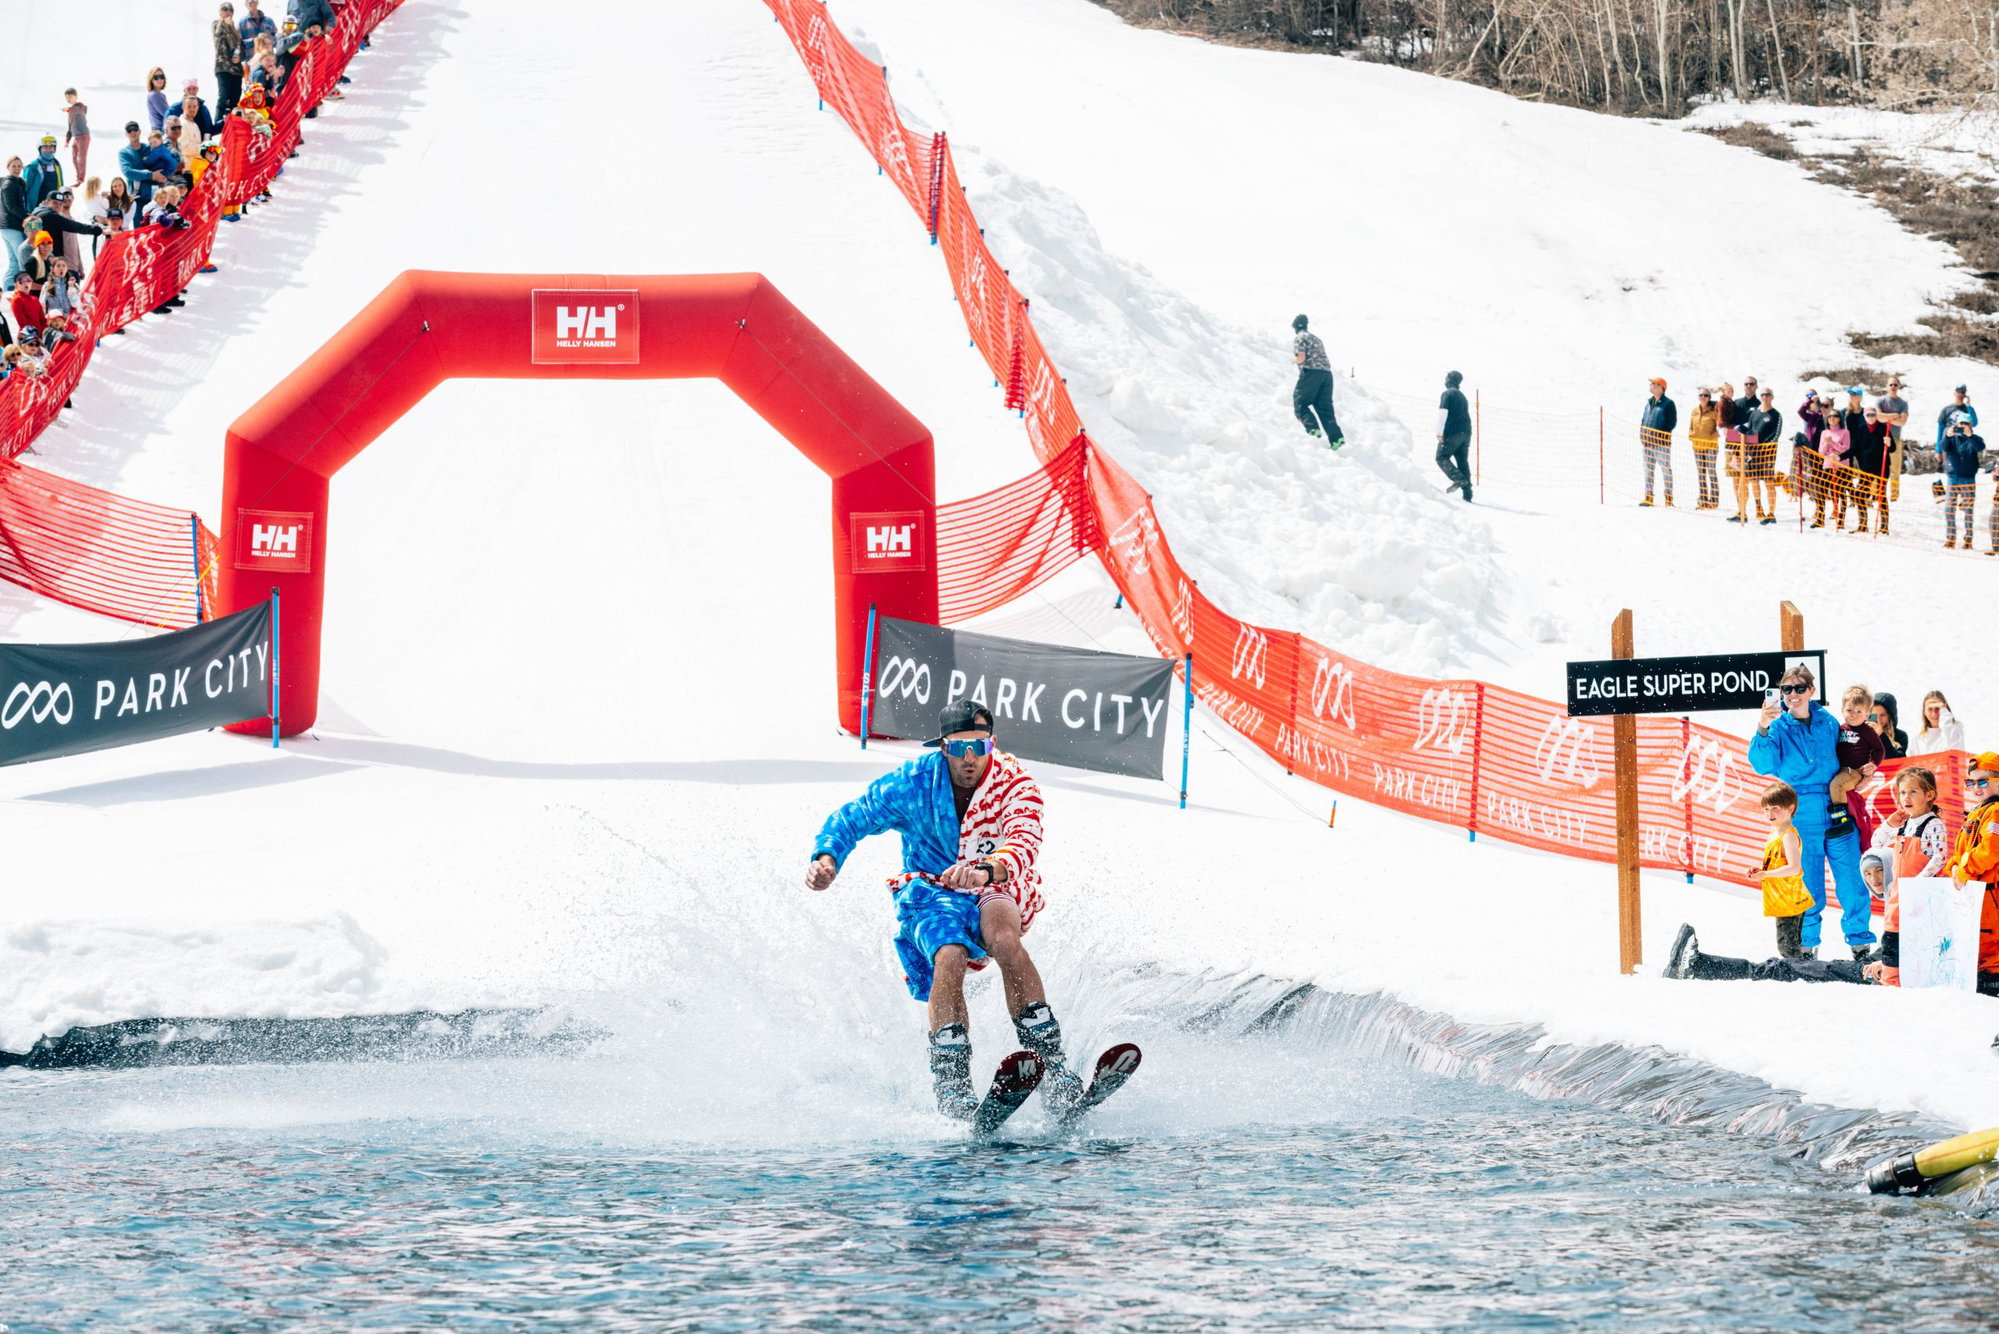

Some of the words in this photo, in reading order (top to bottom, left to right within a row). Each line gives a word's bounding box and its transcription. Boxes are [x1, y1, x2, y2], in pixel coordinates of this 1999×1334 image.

[556, 340, 581, 348] HELLY
[583, 340, 617, 348] HANSEN
[94, 667, 191, 720] PARK
[205, 641, 269, 699] CITY
[947, 670, 1047, 723] PARK
[1061, 688, 1164, 739] CITY
[1576, 675, 1639, 700] EAGLE
[1643, 672, 1706, 697] SUPER
[1711, 670, 1770, 694] POND
[1196, 682, 1237, 719] PARK
[1228, 701, 1265, 737] CITY
[1274, 722, 1311, 766] PARK
[1314, 739, 1349, 782] CITY
[1373, 761, 1416, 802] PARK
[1421, 773, 1462, 813] CITY
[1487, 790, 1535, 834] PARK
[1540, 805, 1588, 845] CITY
[1677, 831, 1729, 874] CITY
